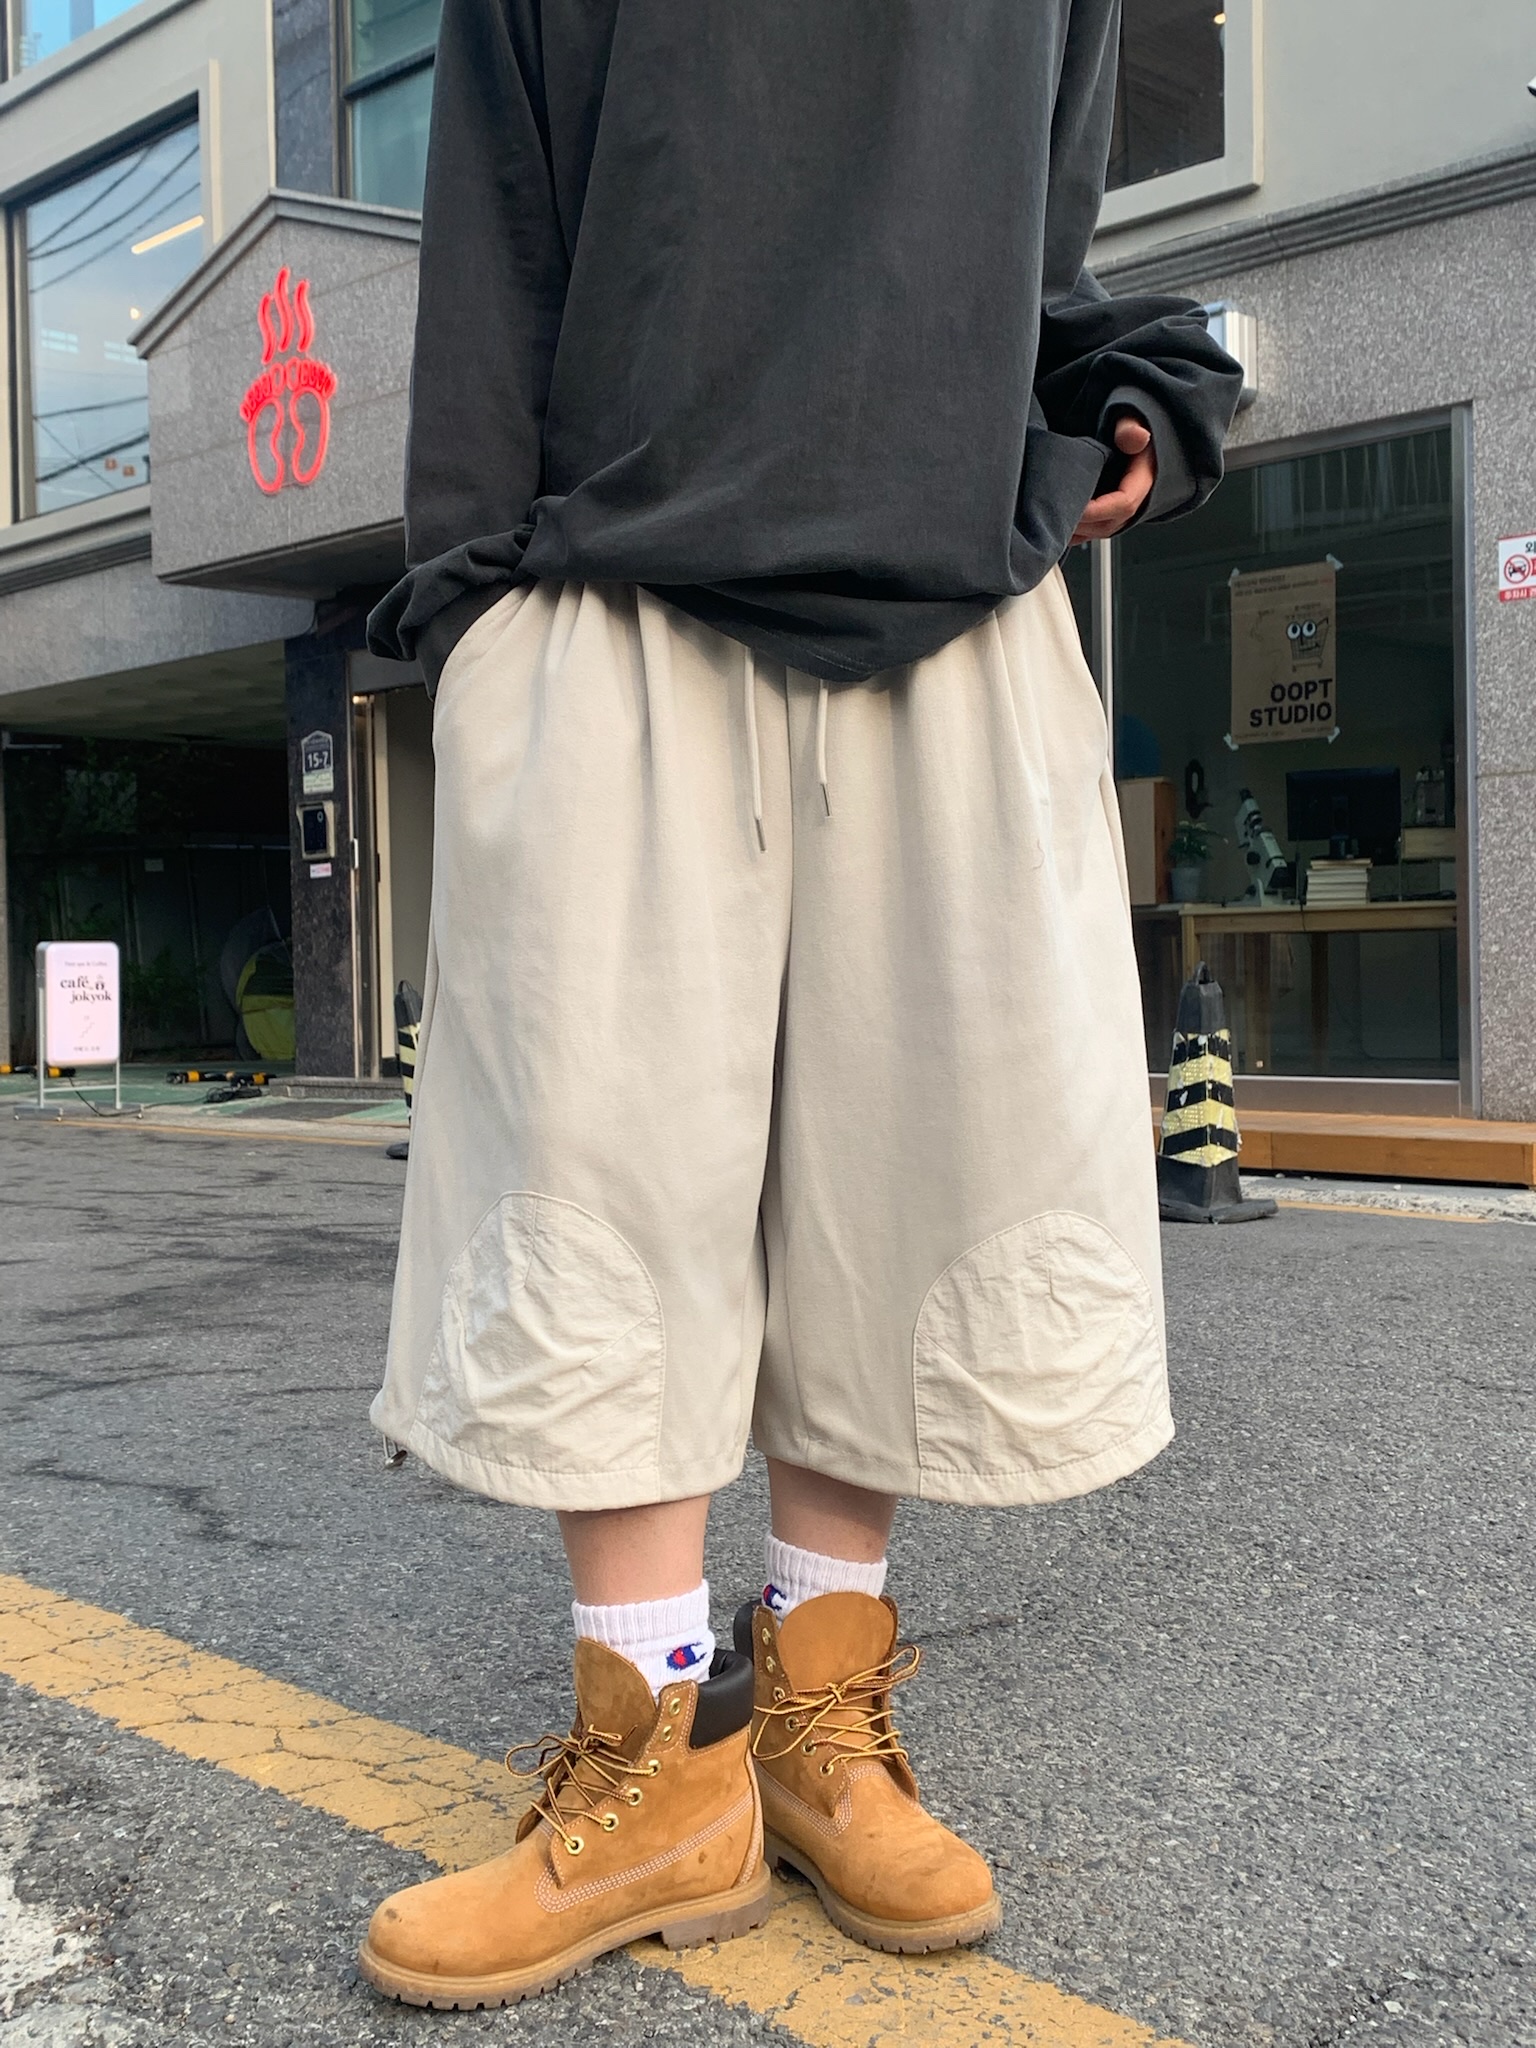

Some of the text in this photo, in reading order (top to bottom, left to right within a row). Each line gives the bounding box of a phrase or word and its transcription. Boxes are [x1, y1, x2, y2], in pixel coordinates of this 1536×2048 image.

[1270, 678, 1333, 703] OOPT
[1249, 701, 1332, 728] STUDIO
[307, 751, 329, 769] 15-7
[60, 975, 89, 989] café
[70, 990, 112, 1004] jokyok
